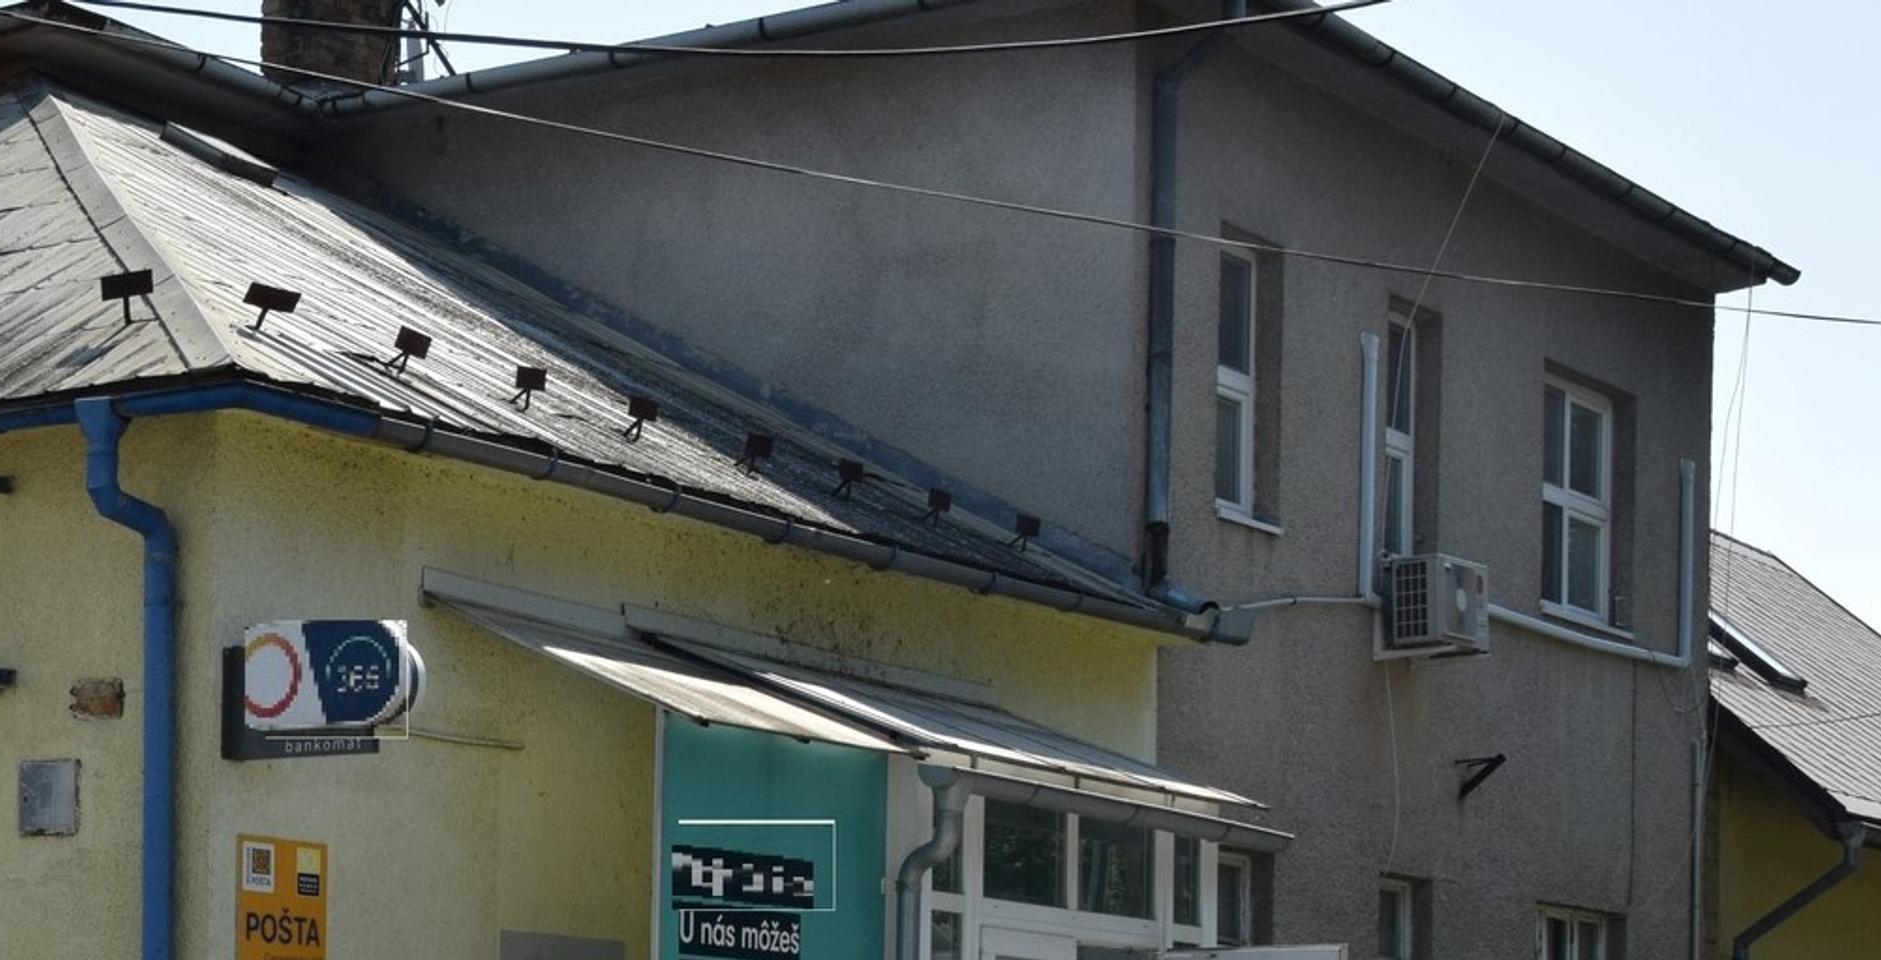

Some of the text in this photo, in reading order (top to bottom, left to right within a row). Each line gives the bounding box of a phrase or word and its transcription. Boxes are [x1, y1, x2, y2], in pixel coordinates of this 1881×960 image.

[285, 738, 361, 752] bankomat
[246, 907, 320, 946] POŠTA
[680, 909, 800, 954] U nás môžeš
